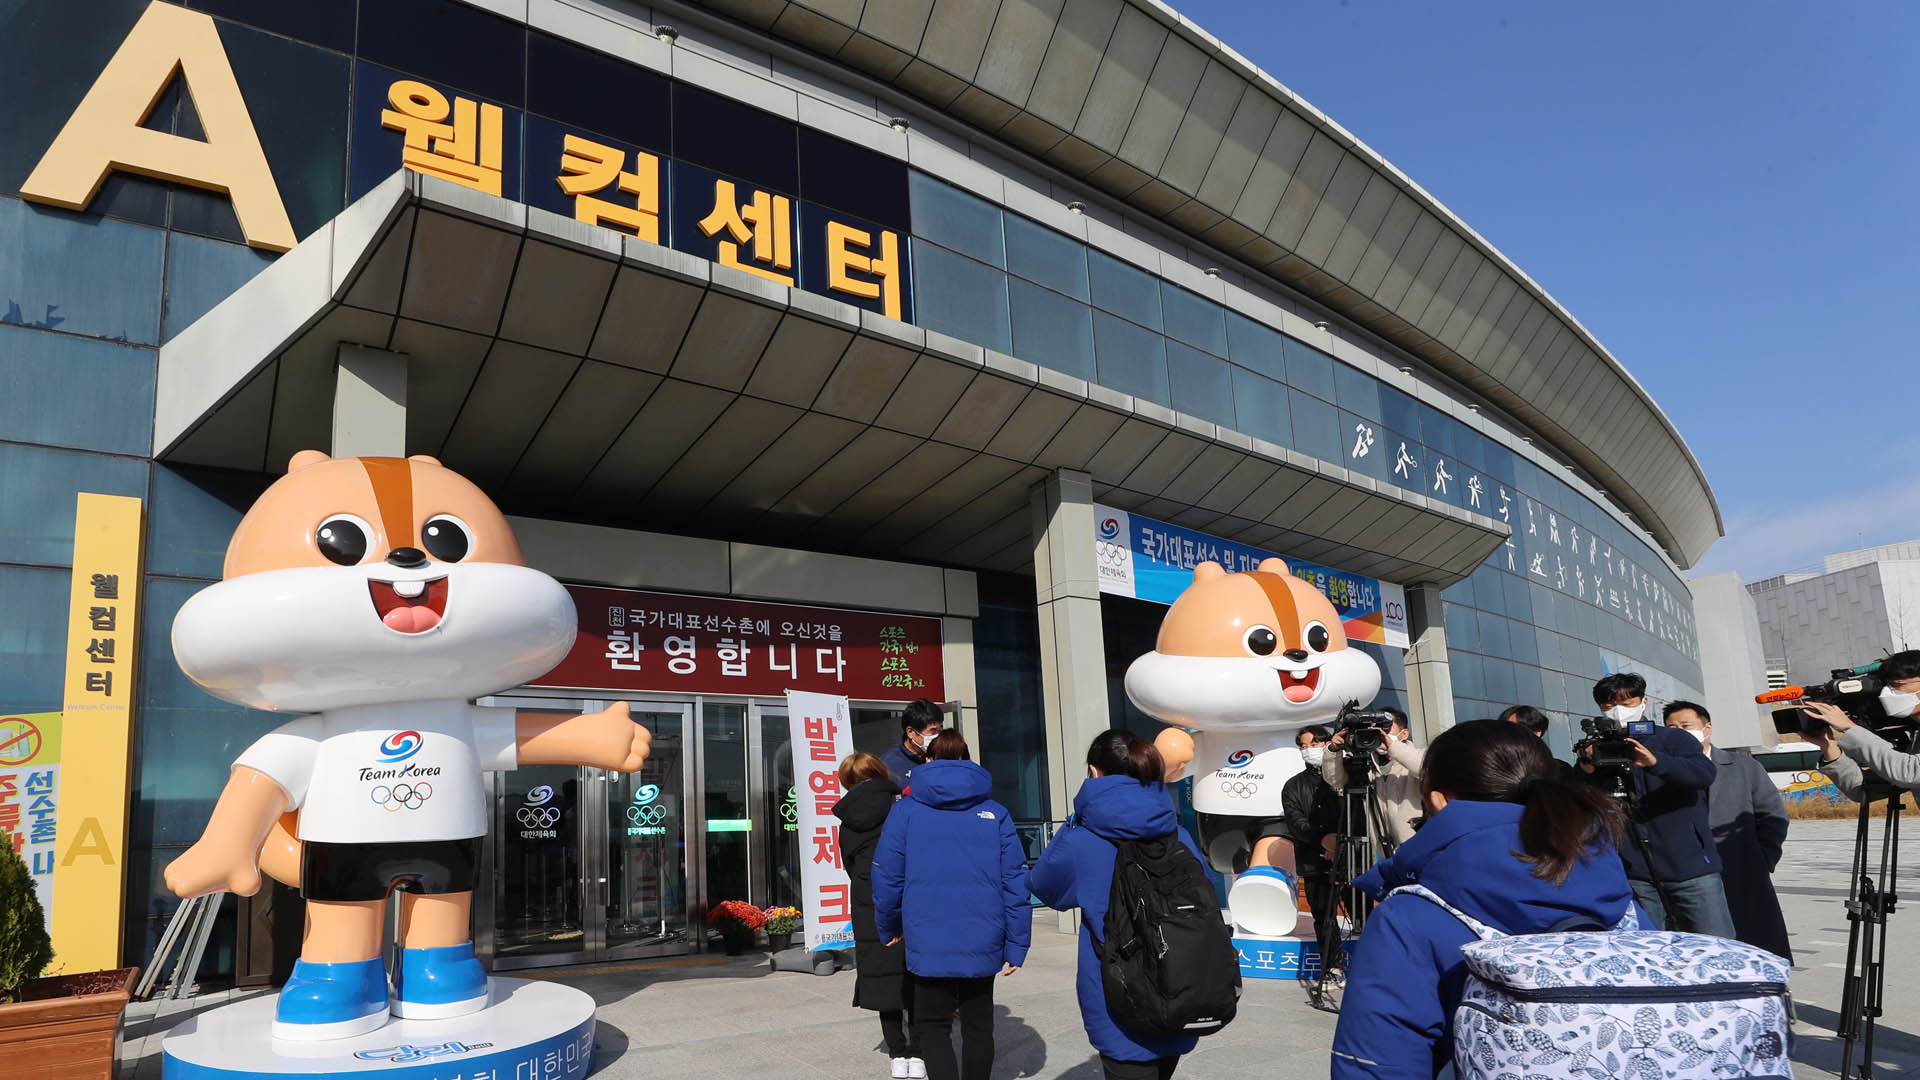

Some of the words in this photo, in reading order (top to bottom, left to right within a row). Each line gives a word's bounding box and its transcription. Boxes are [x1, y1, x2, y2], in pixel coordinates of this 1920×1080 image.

[20, 0, 298, 253] A
[381, 80, 901, 321] 웰컴센터
[1329, 576, 1375, 612] 환영합니다
[1385, 601, 1404, 621] 100
[86, 573, 119, 697] 웰컴센터
[629, 608, 771, 637] 국가대표선수촌에
[780, 621, 843, 642] 오신것을
[880, 626, 906, 639] 스포츠
[605, 630, 847, 682] 환영합니다
[881, 656, 910, 671] 스포츠
[359, 767, 396, 781] Team
[398, 763, 441, 778] Korea
[1215, 769, 1237, 779] Team
[1237, 770, 1265, 780] Korea
[24, 770, 57, 845] 선수촌
[61, 817, 116, 866] A
